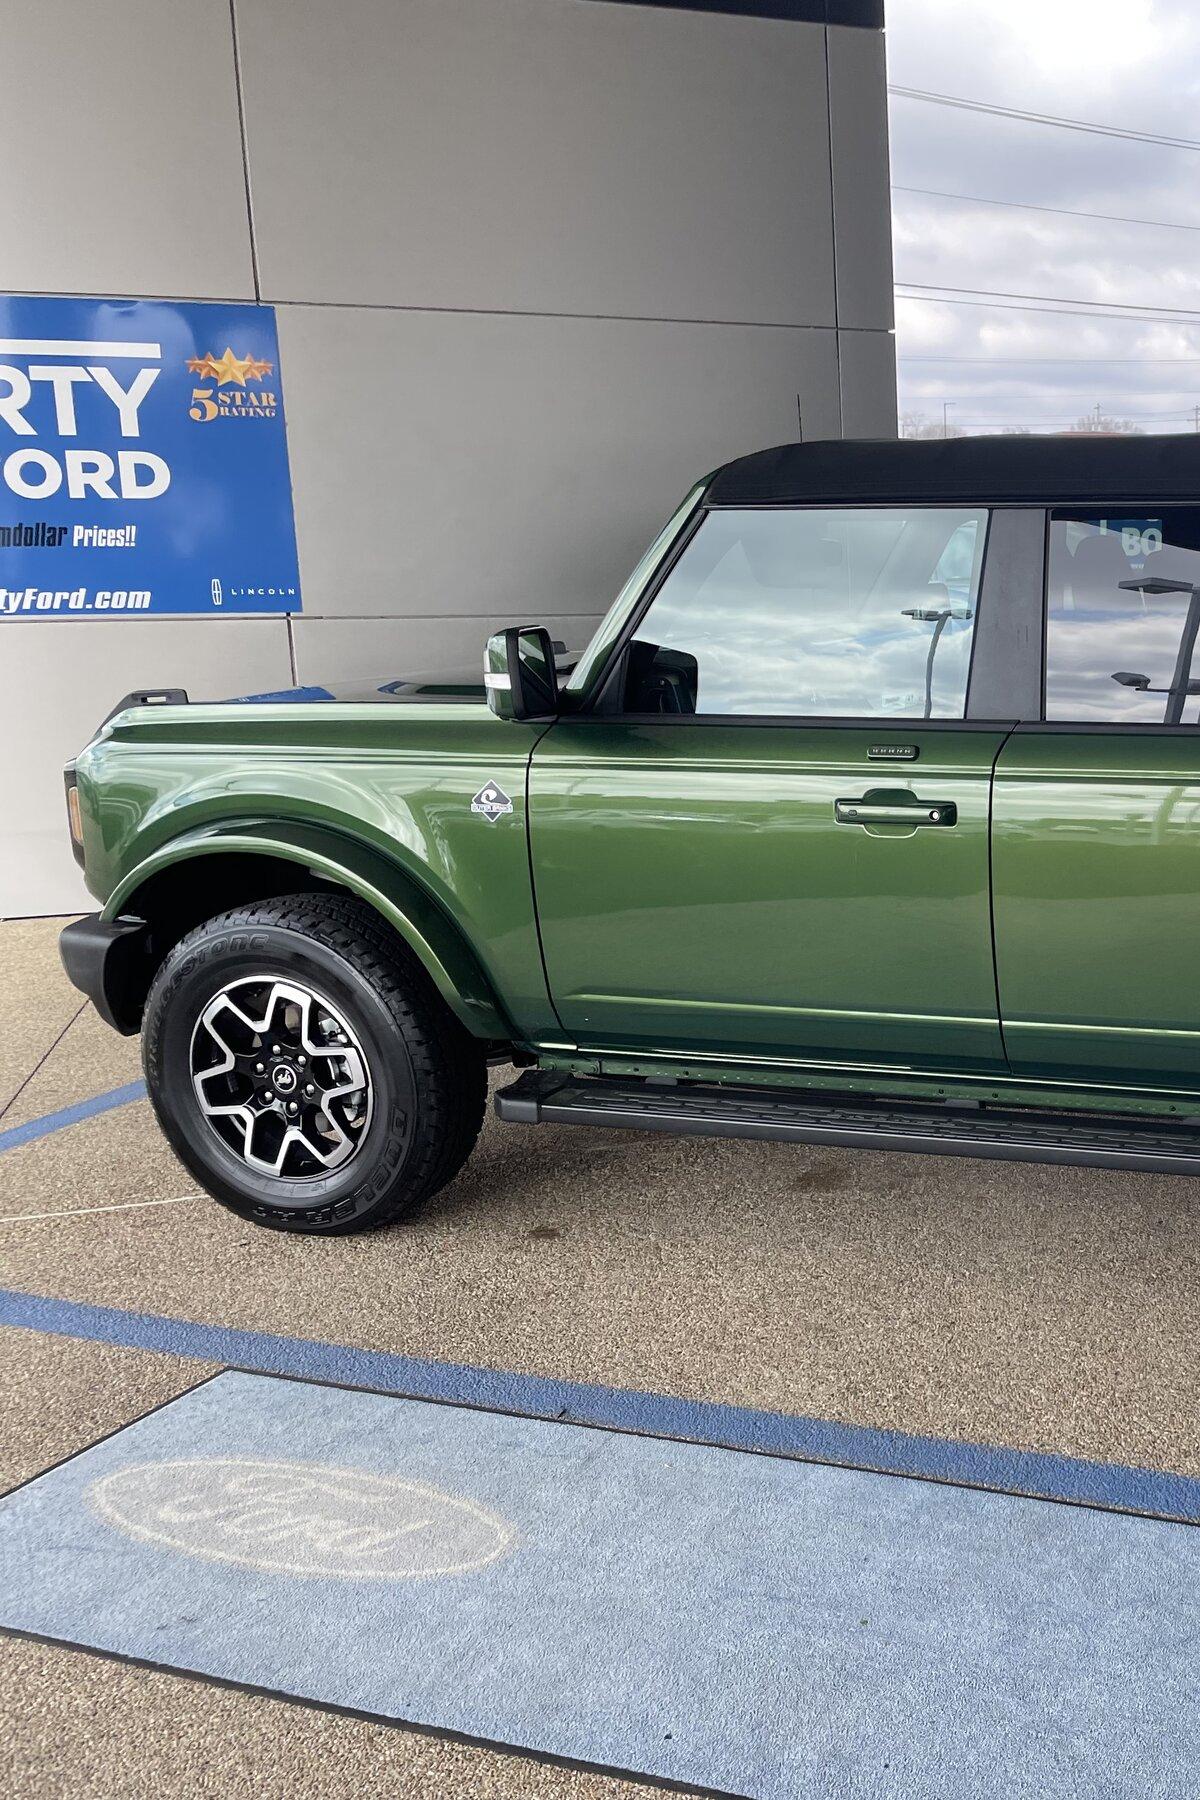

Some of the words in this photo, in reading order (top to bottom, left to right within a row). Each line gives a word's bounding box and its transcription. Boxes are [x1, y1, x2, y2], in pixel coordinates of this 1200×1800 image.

[0, 365, 162, 437] RTY
[189, 388, 218, 421] 5
[218, 391, 277, 407] STAR
[219, 406, 276, 417] RATING
[73, 525, 137, 547] Prices!!
[231, 588, 296, 596] LINCOLN
